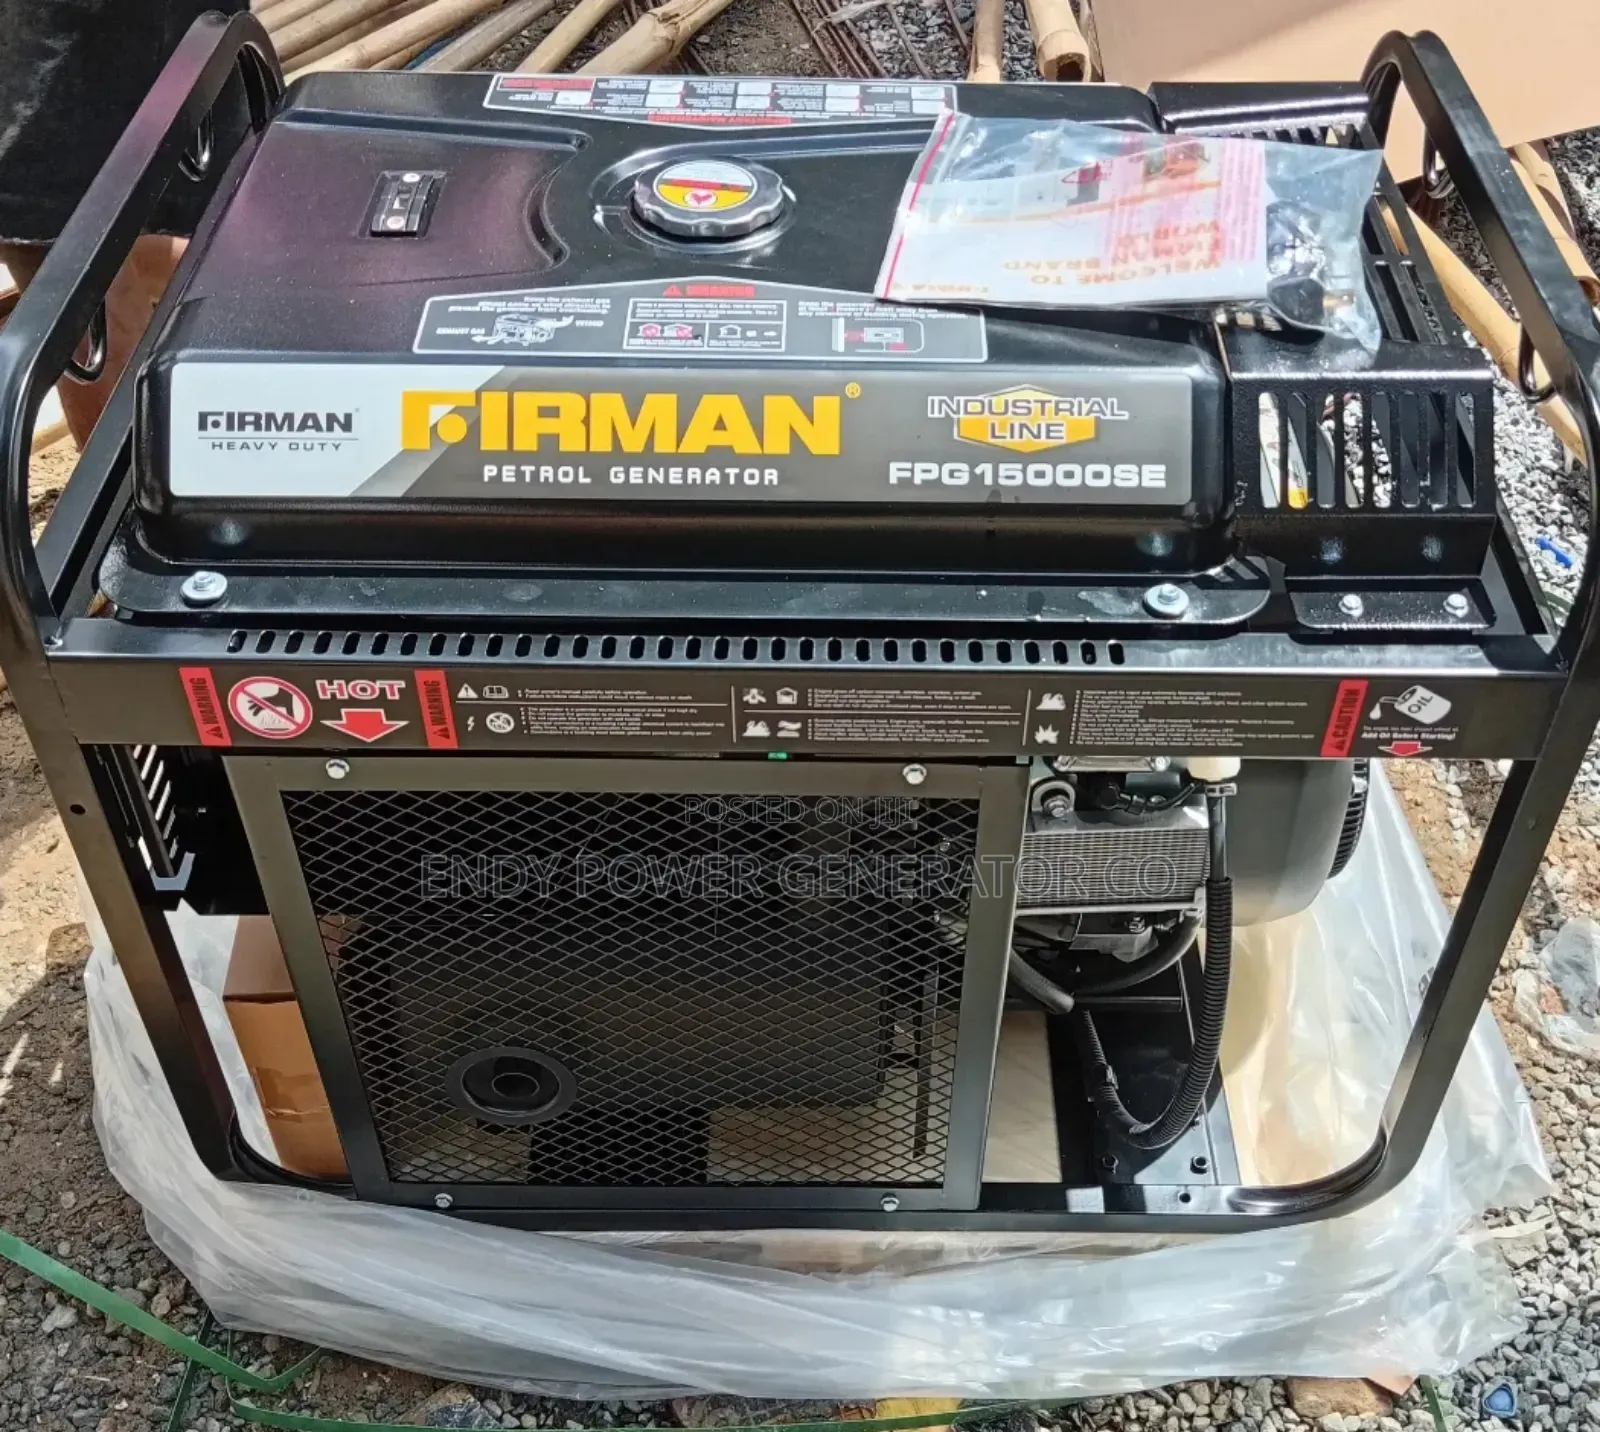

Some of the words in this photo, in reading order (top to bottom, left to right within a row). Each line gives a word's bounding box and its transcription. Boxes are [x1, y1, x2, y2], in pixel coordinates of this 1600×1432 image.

[1030, 275, 1064, 286] TO
[928, 396, 1129, 420] INDUSTRIAL
[989, 421, 1066, 441] LINE
[211, 441, 278, 451] HEAVY
[288, 442, 342, 451] DUTY
[483, 465, 592, 484] PETROL
[609, 466, 779, 486] GENERATOR
[888, 462, 1167, 488] FPG15000SE
[315, 679, 406, 700] HOT
[189, 677, 216, 725] WARNING
[423, 680, 446, 726] WARNING
[1408, 695, 1433, 714] OIL
[1333, 688, 1361, 739] CAUTION
[1421, 732, 1456, 740] Starting!
